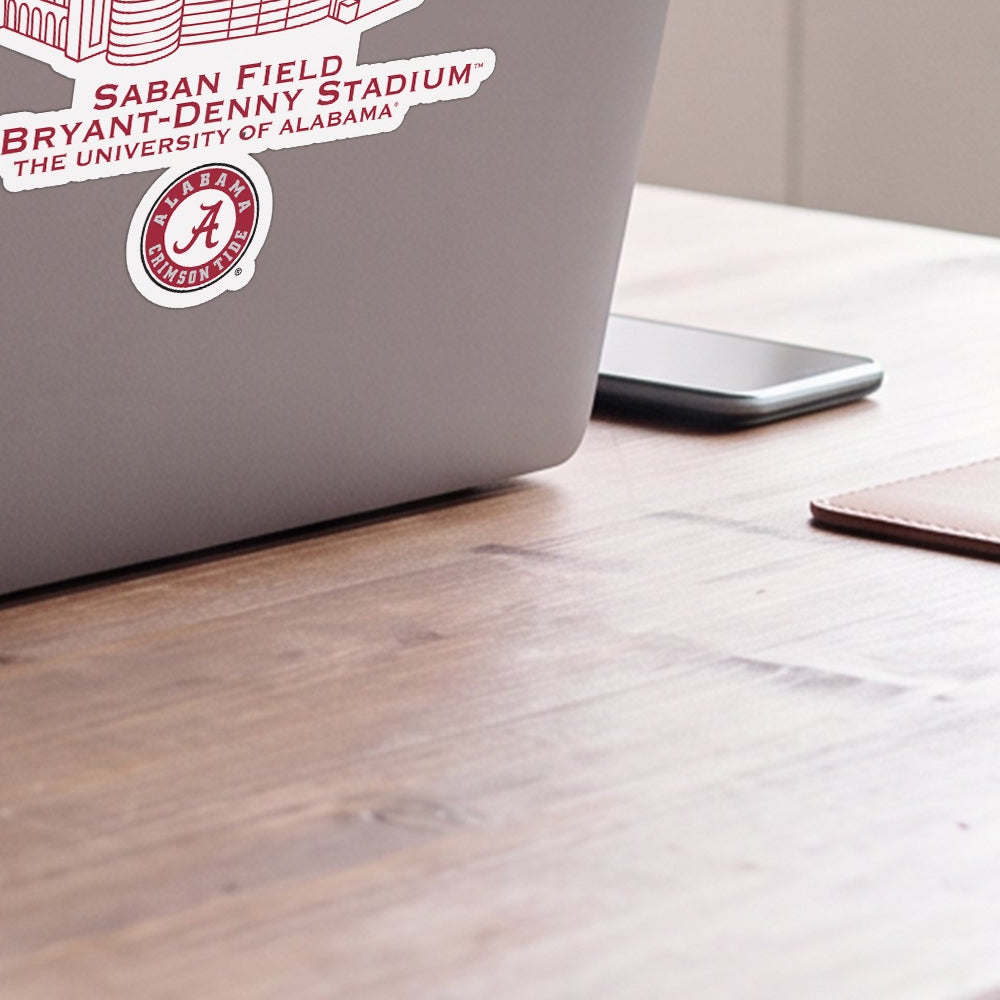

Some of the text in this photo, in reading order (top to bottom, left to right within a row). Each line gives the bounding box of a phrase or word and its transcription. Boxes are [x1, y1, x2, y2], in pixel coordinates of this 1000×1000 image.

[93, 55, 343, 111] SABAN FIELD
[1, 88, 303, 156] BRYANT-DENNY
[13, 153, 67, 177] THE
[76, 127, 231, 168] UNIVERSITY
[238, 121, 273, 141] OF
[153, 172, 251, 227] ALABAMA
[172, 199, 224, 254] A
[147, 229, 248, 285] CRIMSON TIDE
